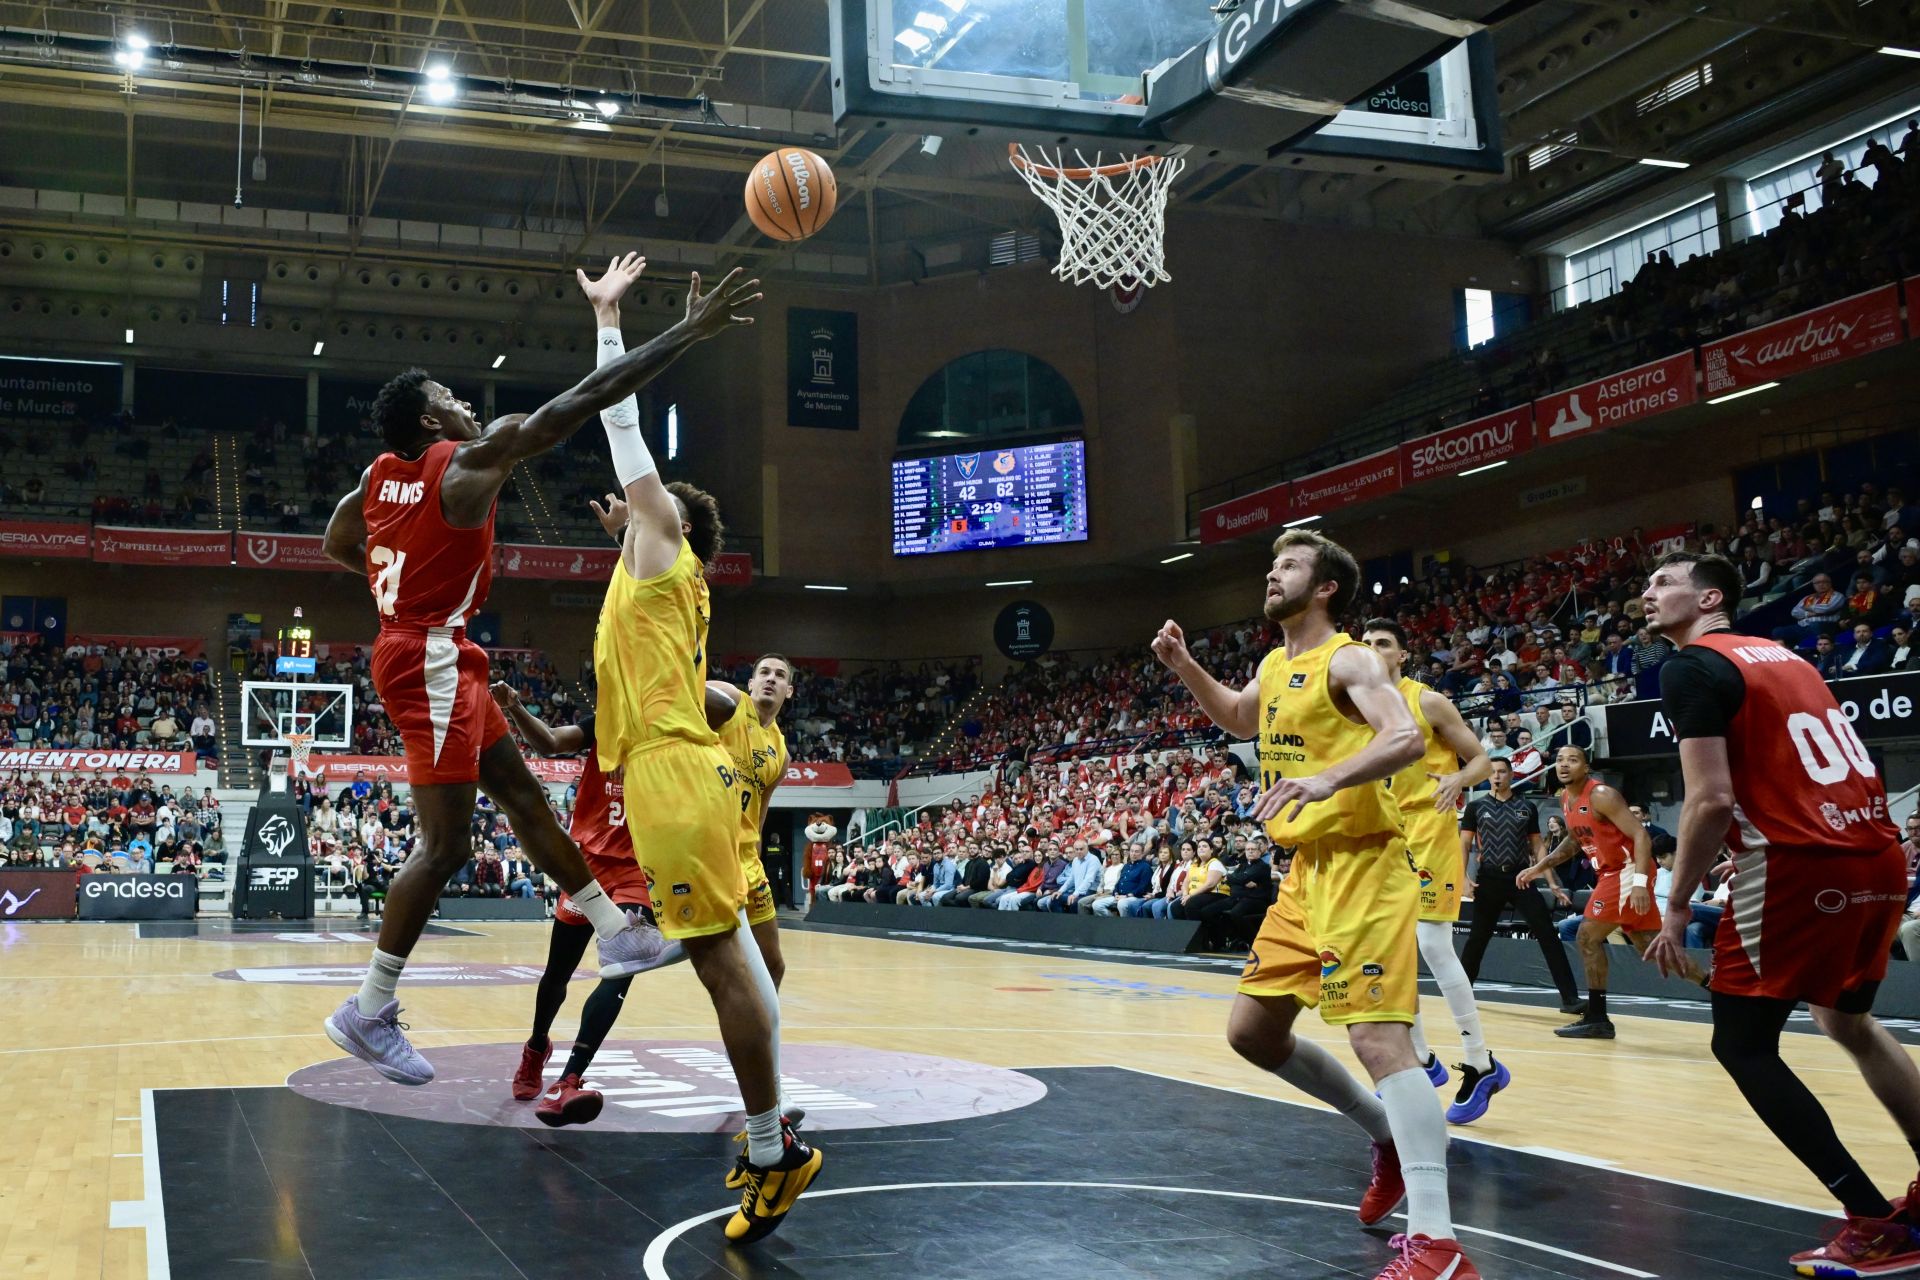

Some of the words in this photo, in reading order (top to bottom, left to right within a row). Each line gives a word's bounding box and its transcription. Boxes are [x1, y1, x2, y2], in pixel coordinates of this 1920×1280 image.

[1370, 96, 1429, 113] endesa
[786, 152, 810, 210] Wilson
[1597, 368, 1666, 402] Asterra
[797, 389, 850, 400] Ayuntamiento
[17, 398, 75, 415] Murcia
[804, 401, 814, 409] de
[816, 402, 843, 411] Murcia
[1598, 387, 1679, 424] Partners
[1411, 420, 1518, 469] setcomur
[378, 480, 425, 504] ENNIS
[996, 482, 1014, 497] 62
[1310, 483, 1349, 501] ESTRELLA
[1354, 466, 1395, 488] LEVANTE
[959, 486, 976, 500] 42
[971, 502, 1002, 515] 2:29
[1227, 506, 1269, 530] bakertilly
[0, 533, 39, 544] ERIA
[41, 535, 86, 545] VITAE
[119, 542, 171, 552] ESTRELLA
[180, 544, 226, 553] LEVANTE
[280, 547, 292, 556] V2
[370, 545, 407, 616] 21
[290, 640, 310, 658] 13
[1870, 689, 1913, 719] de
[1787, 708, 1876, 786] 00
[330, 763, 389, 771] IBERIA
[390, 764, 407, 772] VI
[262, 867, 299, 885] FSP
[85, 877, 183, 898] endesa
[1327, 991, 1349, 1001] Mar
